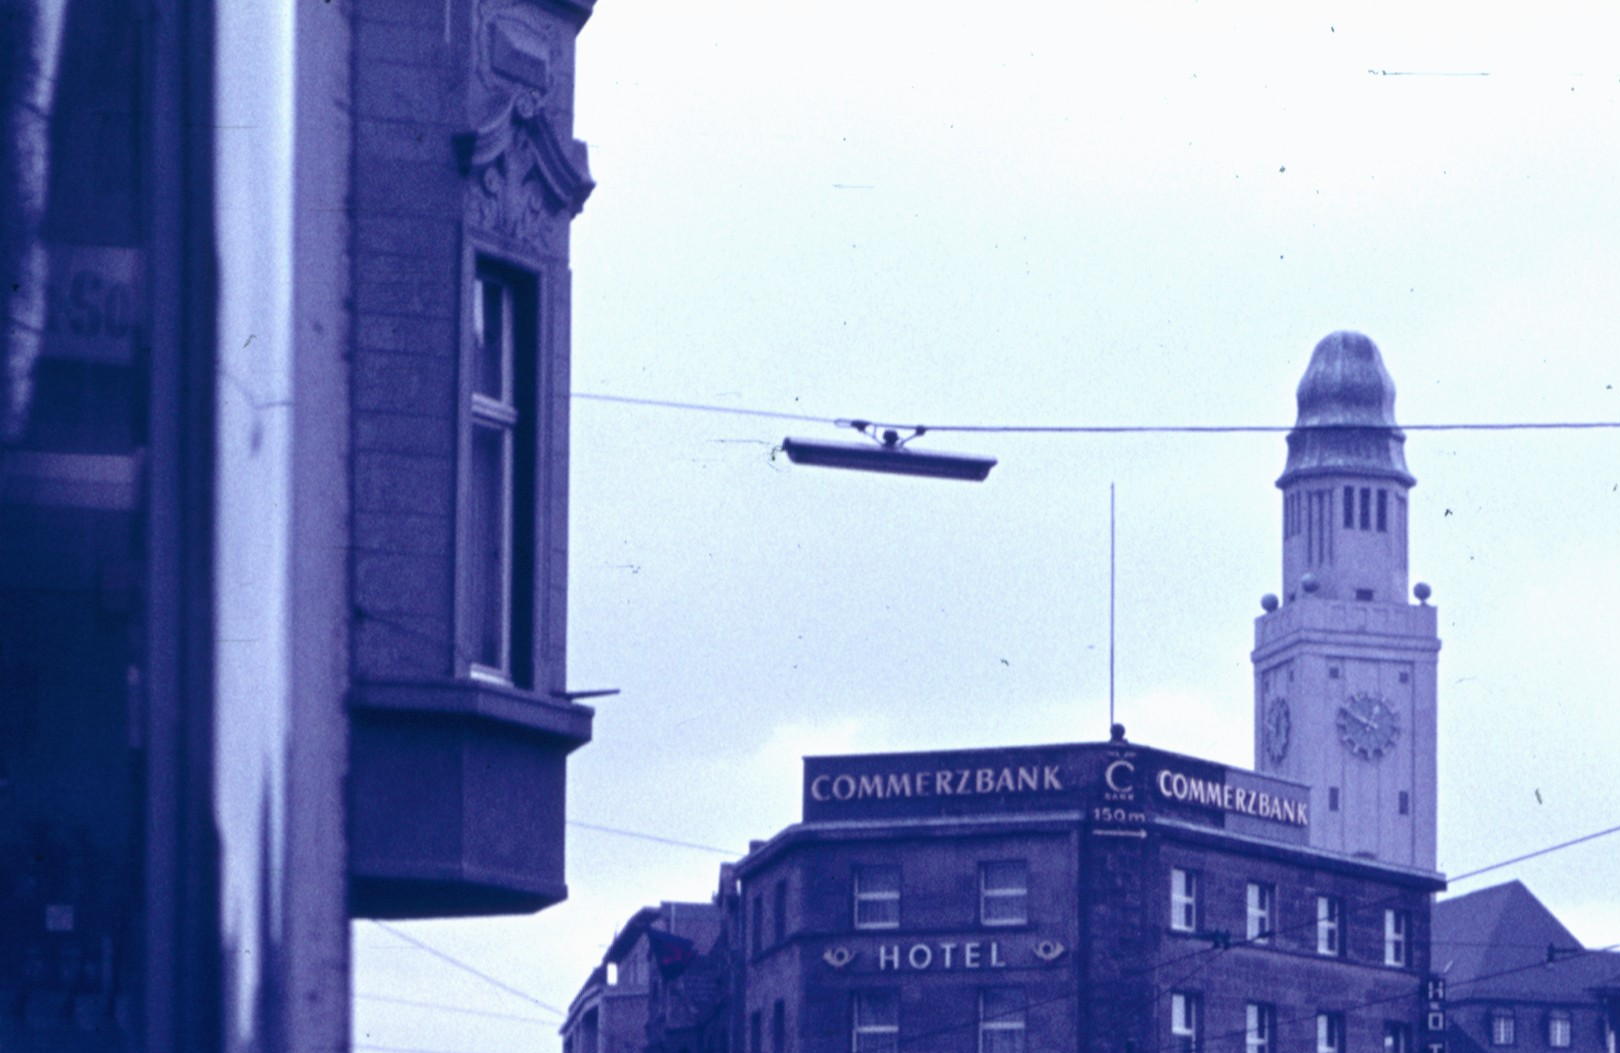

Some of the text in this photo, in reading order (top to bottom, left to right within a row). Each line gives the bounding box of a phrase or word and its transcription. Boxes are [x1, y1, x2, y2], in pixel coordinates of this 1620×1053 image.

[811, 764, 1064, 801] COMMERZBANK
[1158, 770, 1309, 826] COMMERZBANK
[878, 941, 1007, 970] HOTEL
